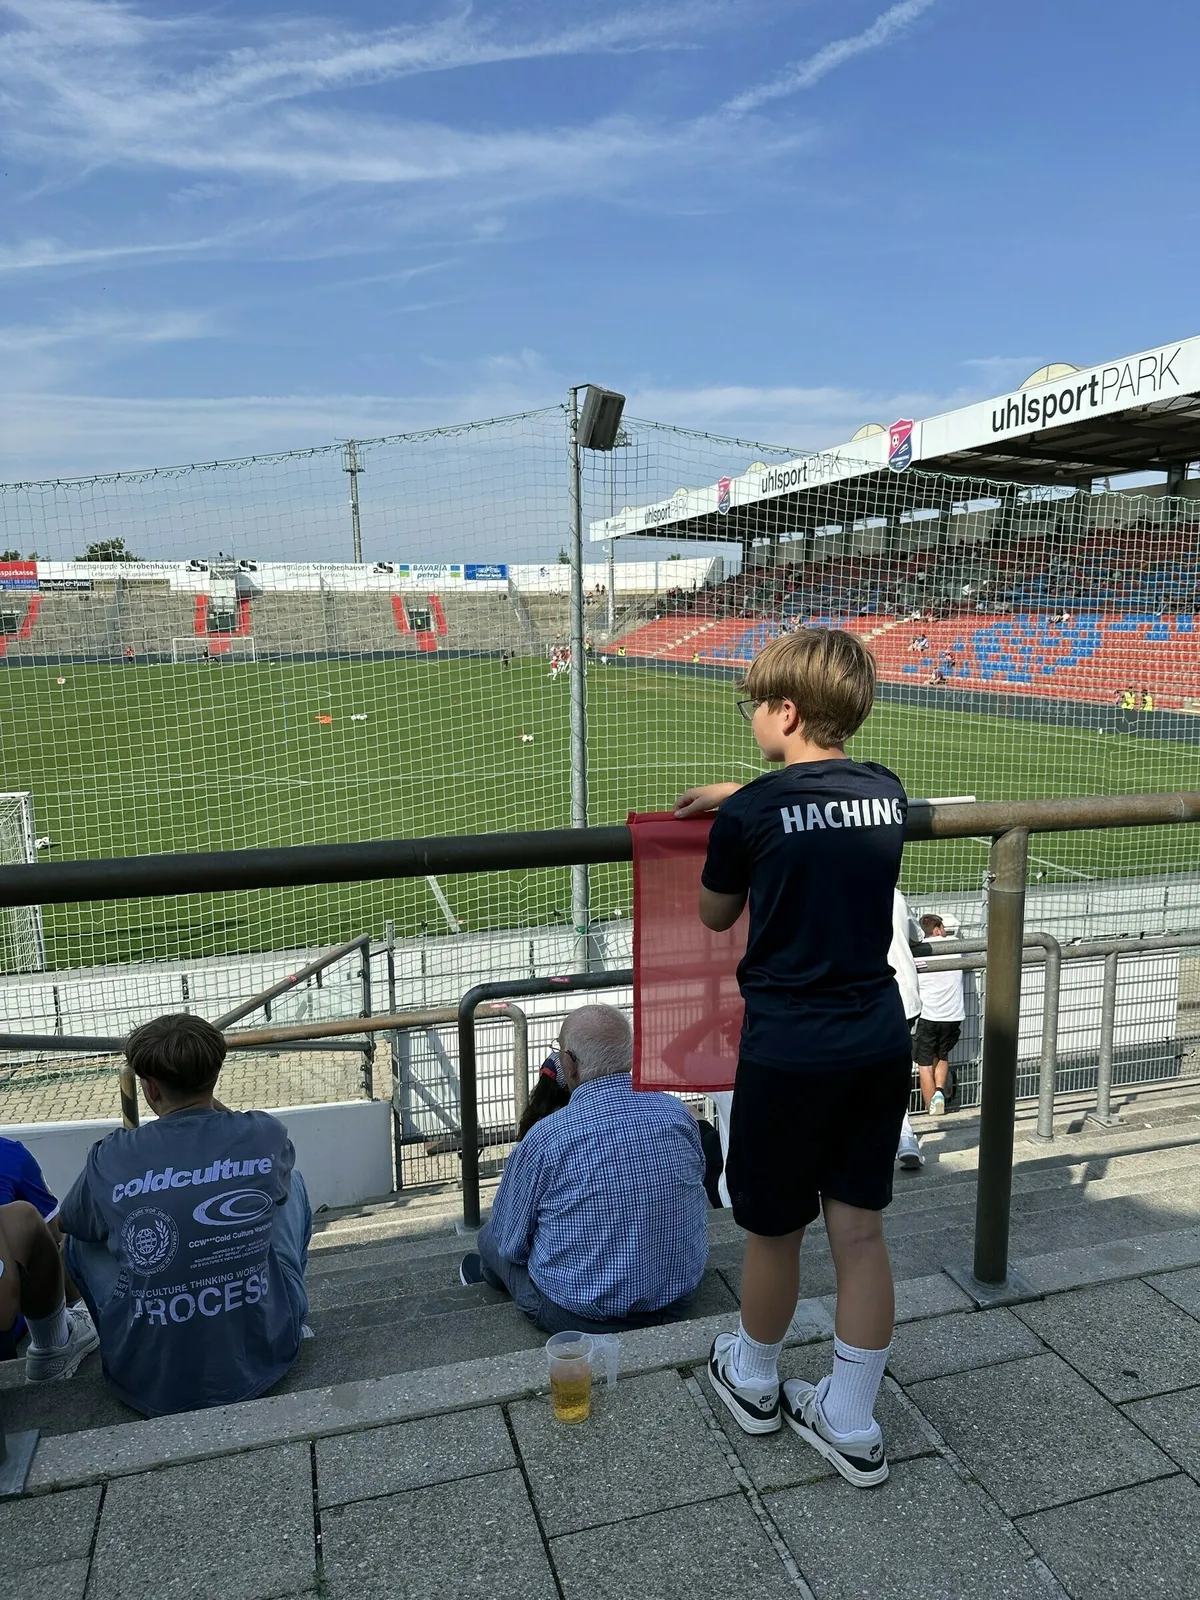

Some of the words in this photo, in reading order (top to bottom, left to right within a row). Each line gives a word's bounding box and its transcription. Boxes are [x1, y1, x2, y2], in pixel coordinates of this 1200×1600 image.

[992, 347, 1182, 432] uhlsportPARK
[761, 449, 841, 494] uhlsportPARK
[0, 568, 34, 577] sparkasse
[417, 571, 441, 579] petrol
[780, 797, 903, 834] HACHING
[112, 1157, 272, 1203] coldculture
[146, 1283, 188, 1298] CULTURE
[190, 1272, 234, 1289] THINKING
